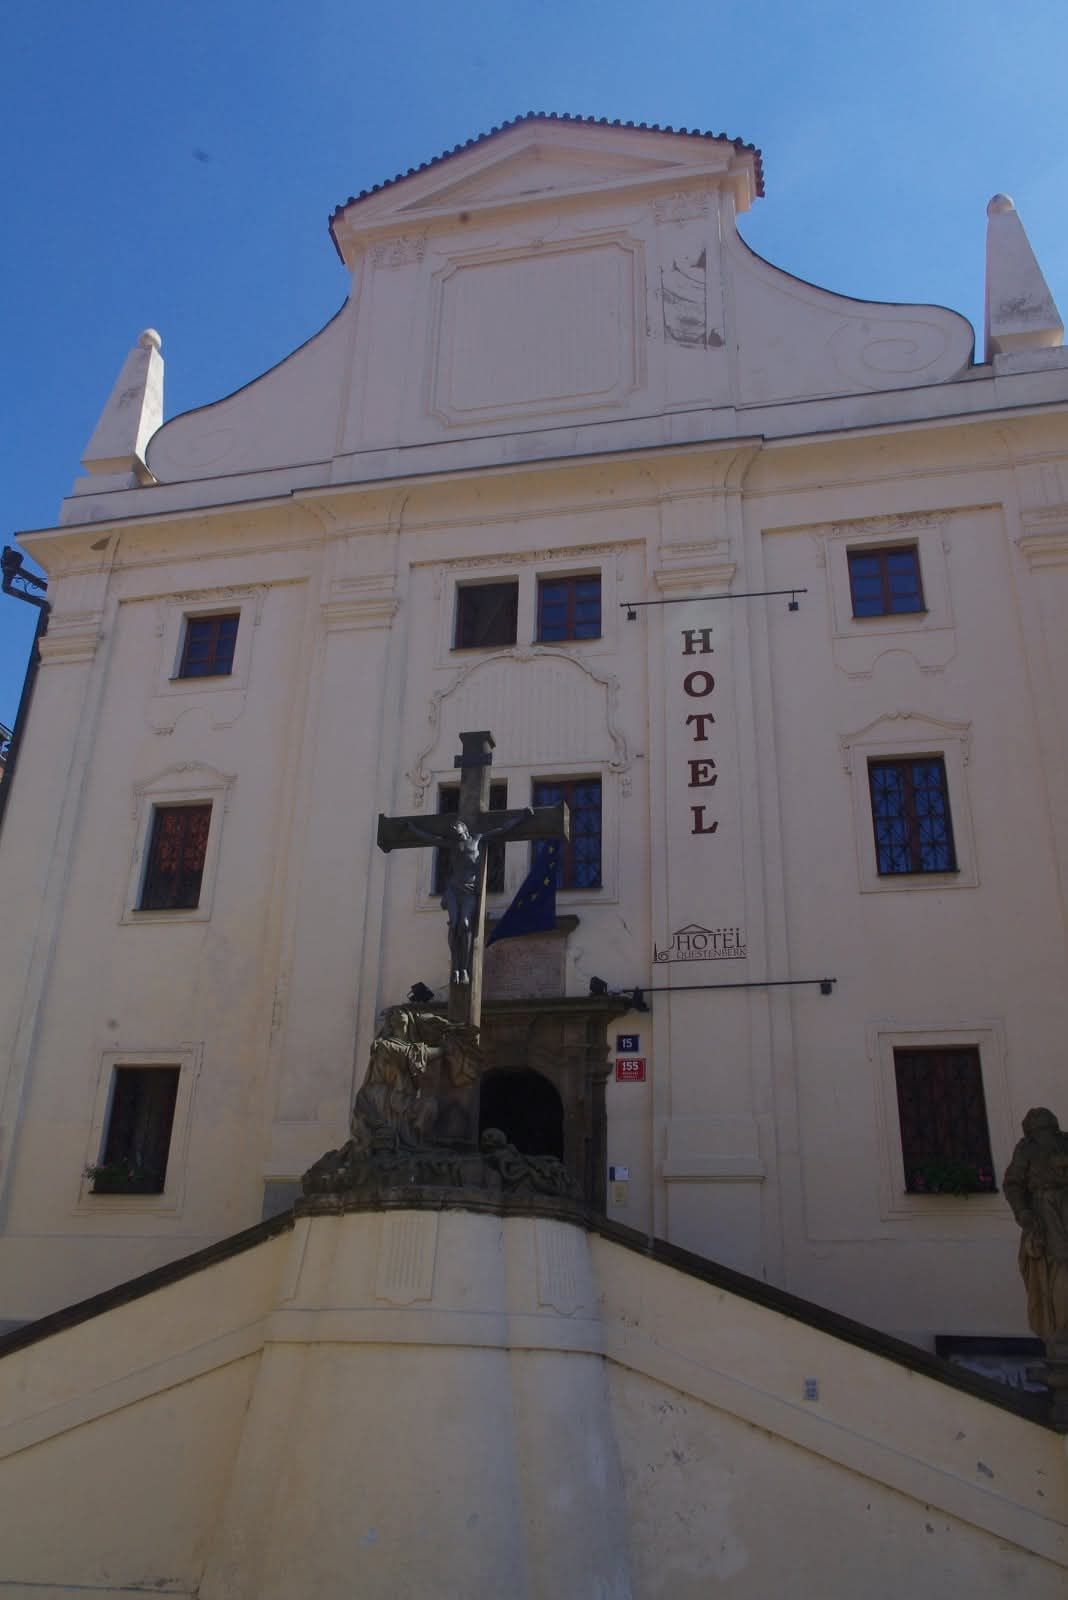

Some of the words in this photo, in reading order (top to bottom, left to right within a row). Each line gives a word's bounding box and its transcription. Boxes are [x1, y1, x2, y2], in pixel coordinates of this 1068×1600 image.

[681, 628, 719, 835] HOTEL
[677, 932, 746, 950] HOTEL
[622, 1038, 633, 1049] 15
[623, 1061, 639, 1071] 155
